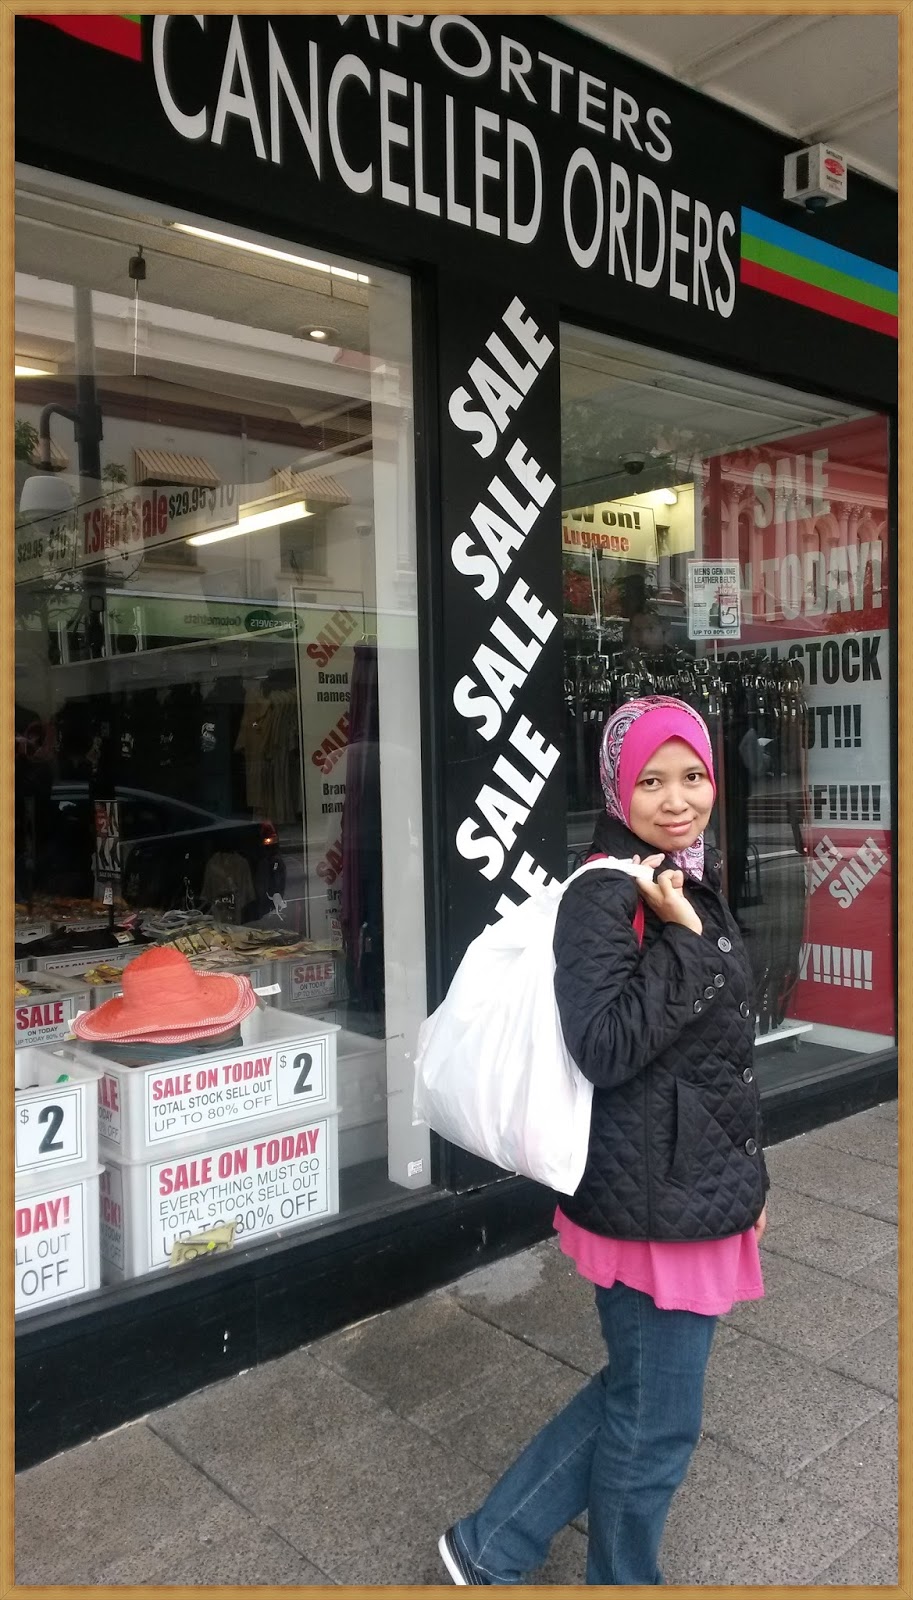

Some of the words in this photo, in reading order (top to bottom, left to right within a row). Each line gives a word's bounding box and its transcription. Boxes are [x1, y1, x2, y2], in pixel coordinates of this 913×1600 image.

[337, 15, 673, 162] PORTERS
[152, 15, 543, 244] CANCELLED
[563, 147, 736, 318] ORDERS
[448, 296, 555, 459] SALE
[752, 448, 832, 529] SALE
[450, 438, 557, 601] SALE
[562, 526, 630, 552] Luggage
[601, 510, 641, 530] on!
[760, 541, 883, 622] TODAY!
[318, 671, 349, 684] Brand
[453, 577, 559, 742] SALE
[316, 691, 351, 702] names
[802, 704, 862, 749] UT!!!
[323, 783, 346, 795] Bran
[455, 714, 561, 882] SALE
[829, 836, 888, 909] SALE!
[293, 962, 333, 984] SALE
[16, 1002, 64, 1030] SALE
[38, 1026, 58, 1034] TODAY
[152, 1074, 192, 1101] SALE
[196, 1068, 219, 1091] ON
[222, 1056, 273, 1084] TODAY
[153, 1100, 186, 1117] TOTAL
[188, 1091, 223, 1109] STOCK
[225, 1086, 251, 1100] SELL
[252, 1080, 273, 1093] OUT
[154, 1118, 177, 1132] UP
[181, 1112, 203, 1126] TO
[207, 1103, 239, 1119] 80%
[243, 1095, 273, 1110] OFF
[159, 1157, 212, 1196] SALE
[218, 1147, 248, 1179] ON
[253, 1128, 320, 1169] TODAY
[159, 1176, 253, 1216] EVERYTHING
[257, 1164, 295, 1186] MUST
[299, 1158, 320, 1174] GO
[160, 1208, 204, 1232] TOTAL
[207, 1194, 255, 1216] STOCK
[257, 1182, 289, 1201] SELL
[292, 1173, 319, 1191] OUT
[280, 1191, 318, 1219] OFF
[16, 1195, 70, 1238] DAY!
[37, 1233, 70, 1258] OUT
[21, 1259, 69, 1296] OFF
